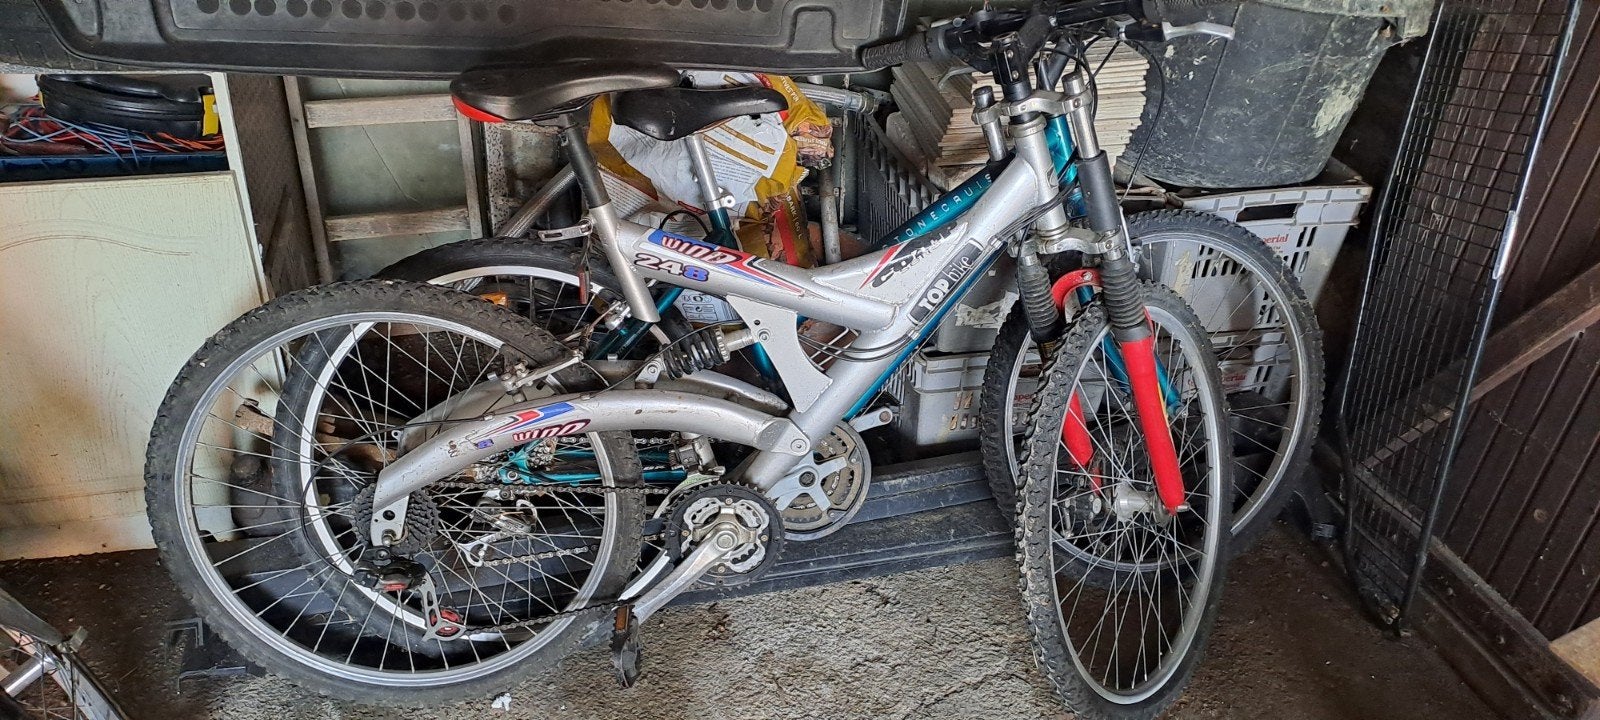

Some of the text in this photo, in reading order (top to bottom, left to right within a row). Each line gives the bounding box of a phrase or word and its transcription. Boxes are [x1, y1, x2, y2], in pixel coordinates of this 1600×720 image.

[634, 252, 709, 281] 248
[920, 278, 950, 313] TOP
[946, 255, 974, 283] bike
